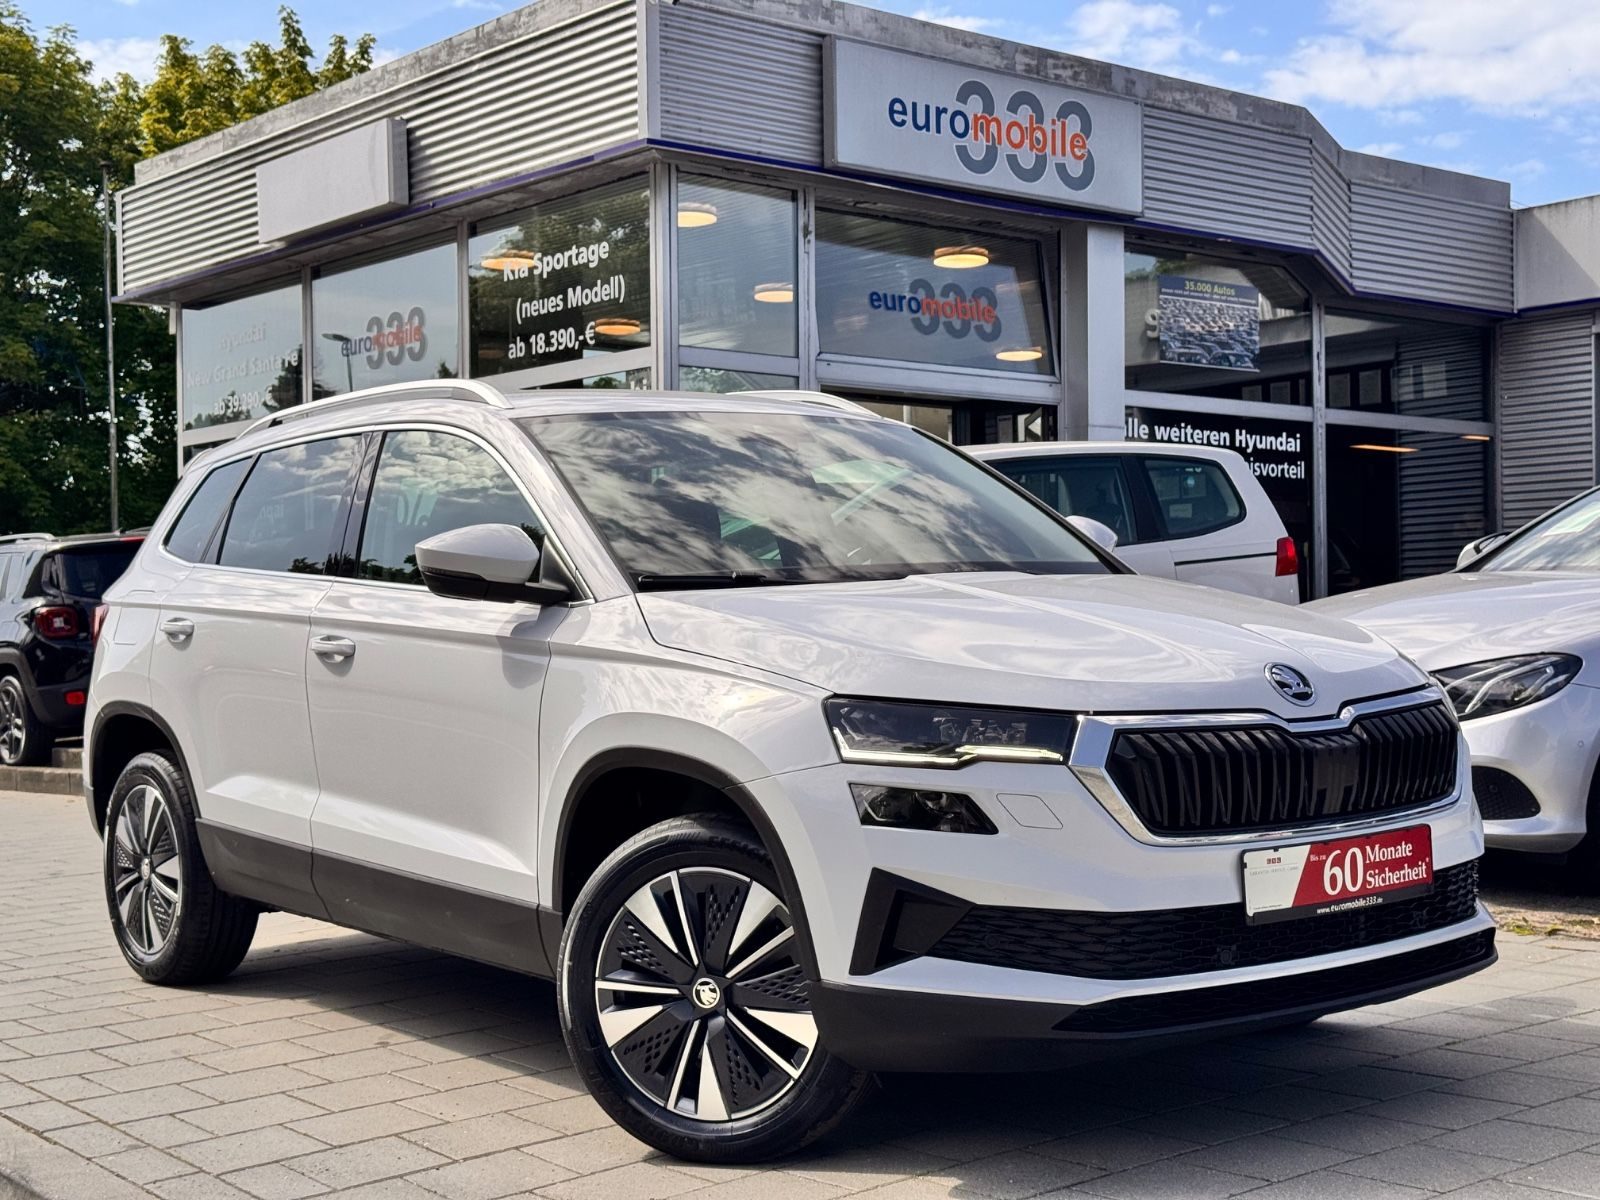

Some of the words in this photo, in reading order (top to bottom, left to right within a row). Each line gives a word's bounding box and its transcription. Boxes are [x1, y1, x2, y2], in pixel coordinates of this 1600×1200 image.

[888, 97, 1087, 161] euromobile
[533, 241, 609, 279] Sportage
[516, 297, 563, 325] (neues
[567, 274, 625, 308] Modell)
[1184, 280, 1211, 293] 35.000
[1213, 283, 1235, 296] Autos
[869, 291, 996, 325] euromobile
[508, 336, 525, 359] ab
[213, 358, 249, 383] Grand
[250, 354, 281, 376] Santa
[1125, 417, 1149, 439] lle
[1154, 422, 1230, 446] weiteren
[1235, 428, 1301, 453] Hyundai
[1246, 457, 1305, 480] isvorteil
[1365, 841, 1412, 864] Monate
[1323, 847, 1364, 896] 60
